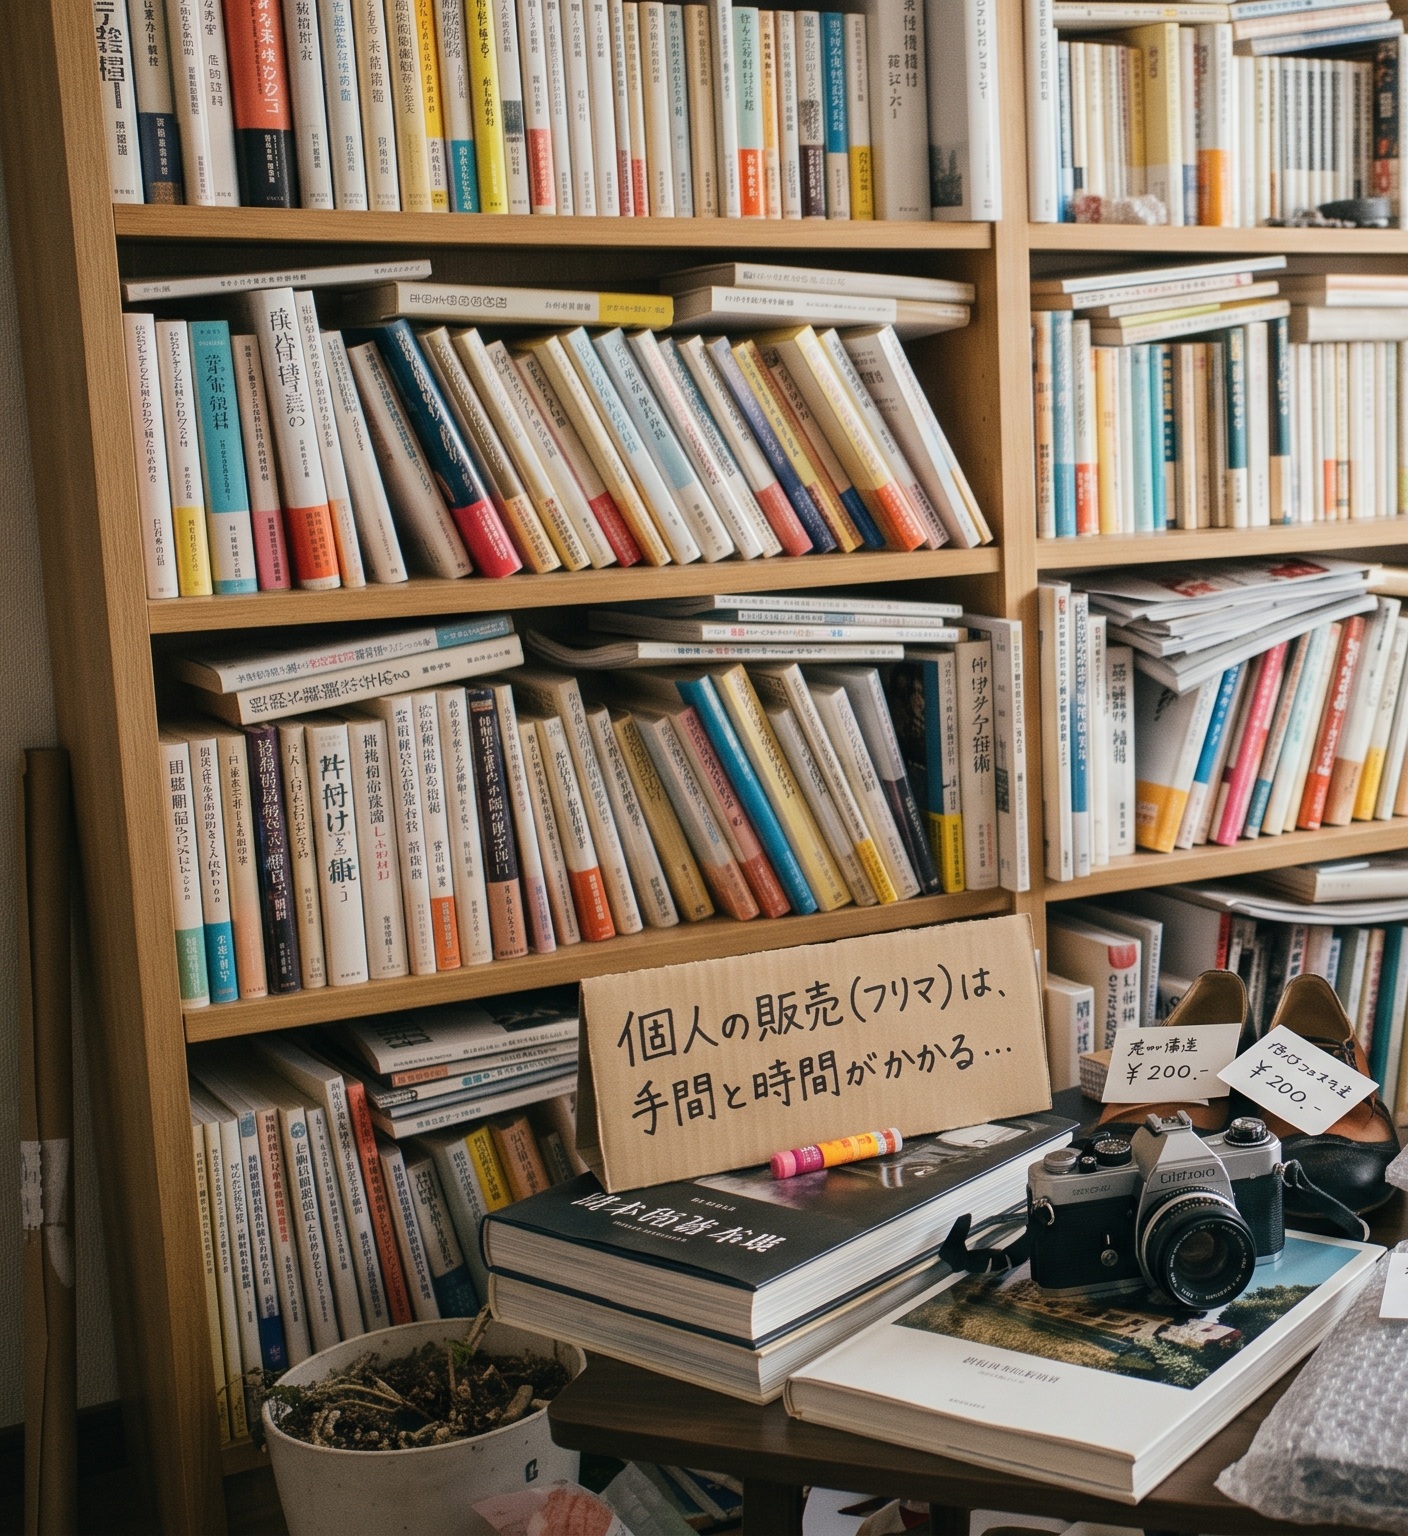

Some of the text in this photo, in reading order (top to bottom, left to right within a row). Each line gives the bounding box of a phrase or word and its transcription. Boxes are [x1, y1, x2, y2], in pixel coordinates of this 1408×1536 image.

[617, 963, 1006, 1067] 個人の販売(フリマ)は、
